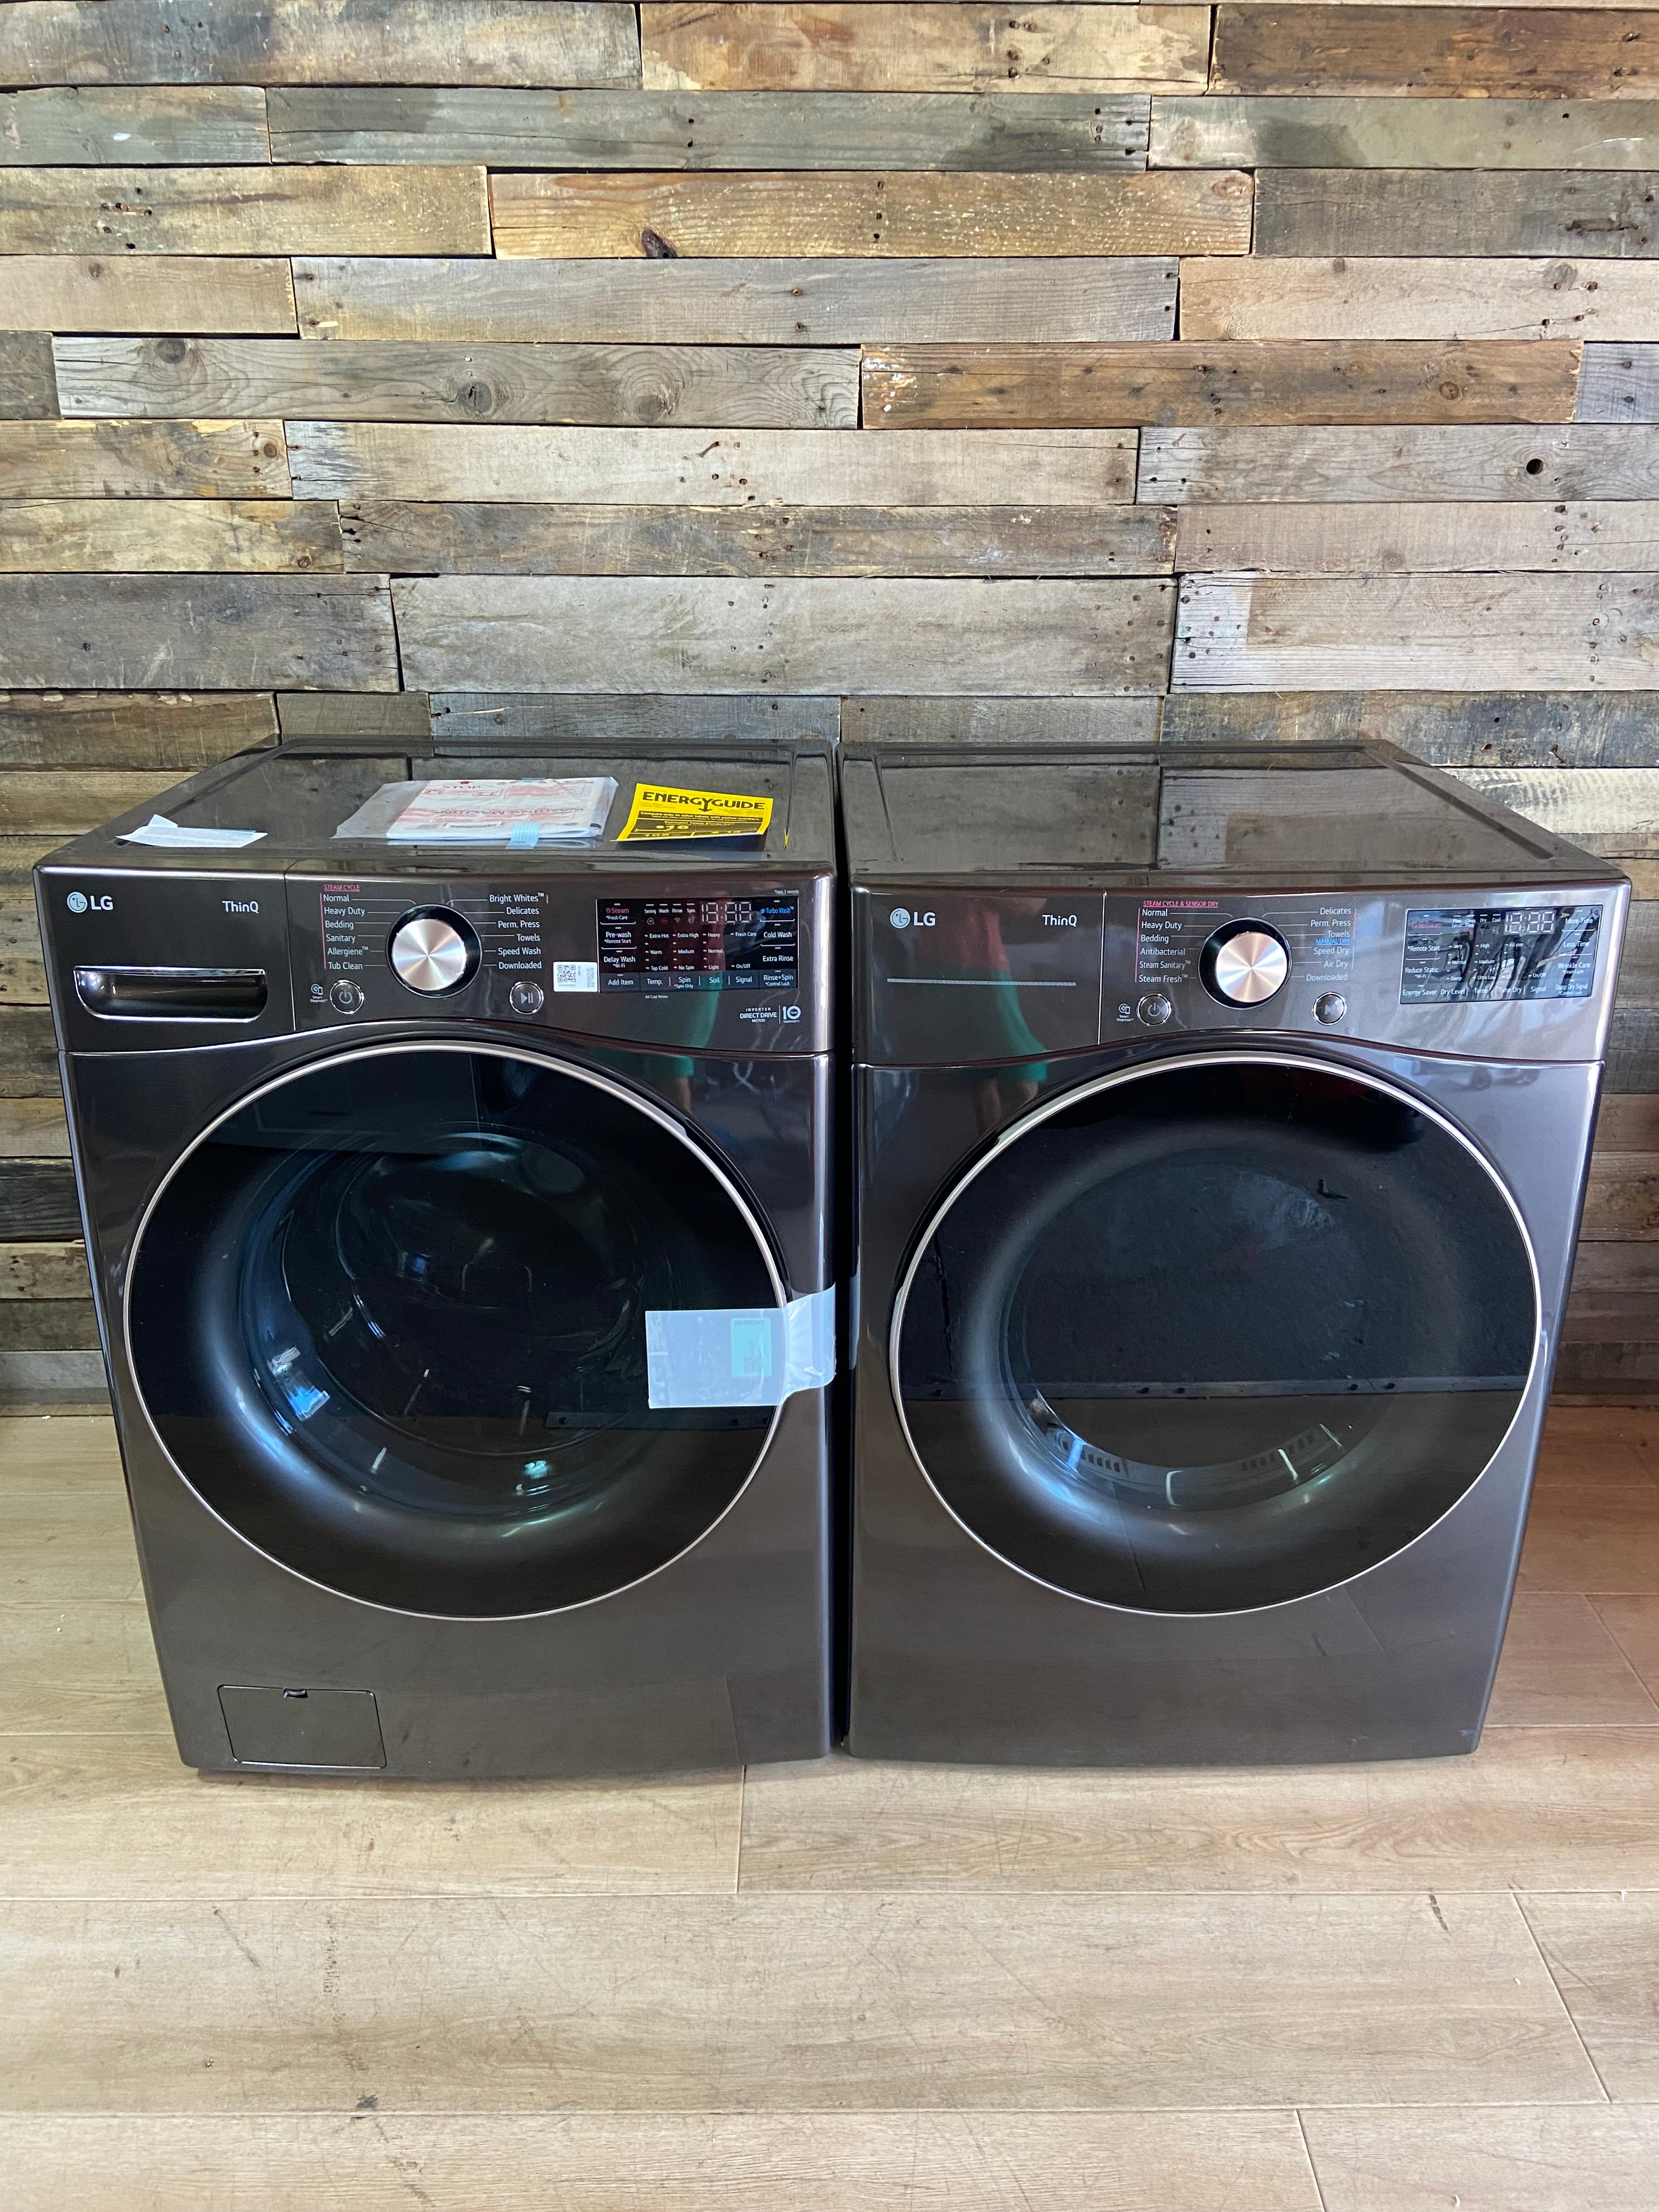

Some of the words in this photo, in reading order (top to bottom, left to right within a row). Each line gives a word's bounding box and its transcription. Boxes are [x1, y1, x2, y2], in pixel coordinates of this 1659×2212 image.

[642, 792, 765, 810] ENERGYGUIDE
[91, 896, 113, 910] LG
[489, 895, 511, 904] Bright
[222, 900, 259, 913] ThinQ
[348, 907, 365, 917] Duty
[913, 912, 935, 926] LG
[1042, 915, 1077, 927] ThinQ
[325, 921, 353, 930] Bedding
[1141, 921, 1163, 930] Heavy
[1165, 921, 1182, 930] Duty
[326, 934, 355, 943] Sanitary
[1141, 934, 1169, 944] Bedding
[498, 947, 520, 957] Speed
[1313, 947, 1335, 956] Speed
[1337, 947, 1349, 956] Dry
[1336, 960, 1348, 969] Dry
[783, 1006, 801, 1019] 10
